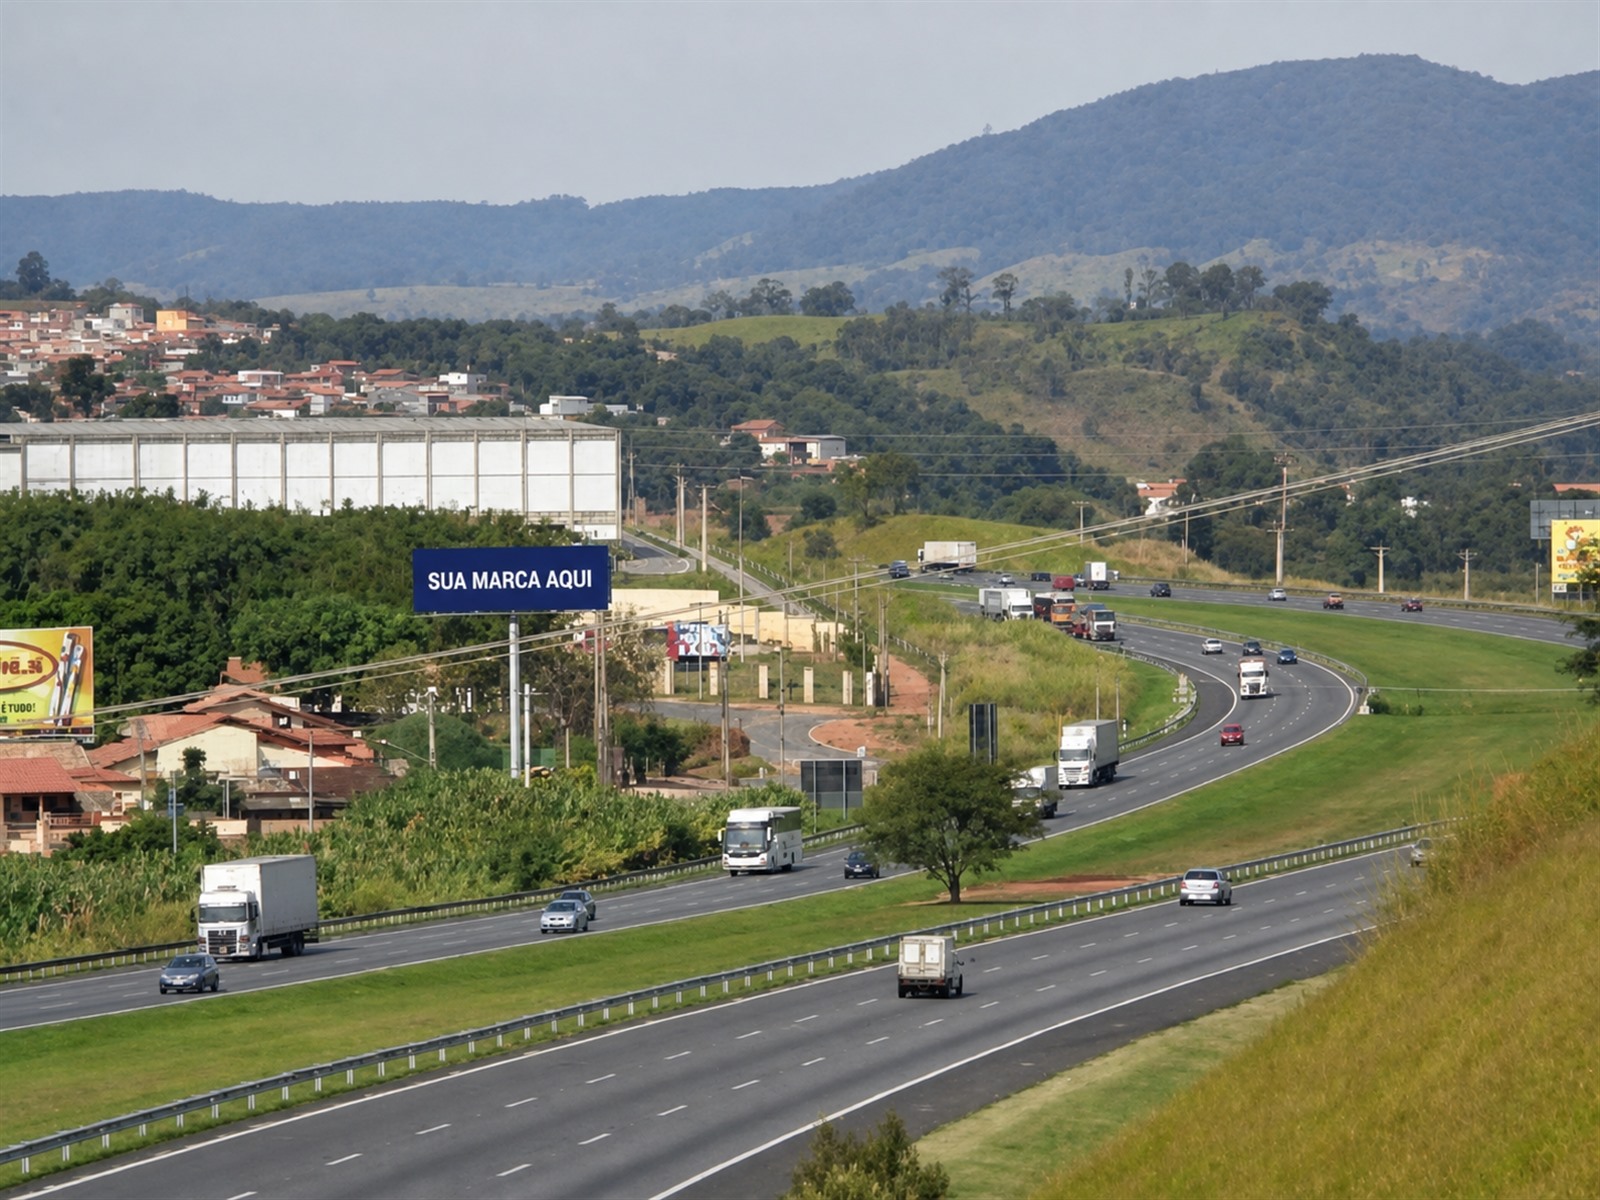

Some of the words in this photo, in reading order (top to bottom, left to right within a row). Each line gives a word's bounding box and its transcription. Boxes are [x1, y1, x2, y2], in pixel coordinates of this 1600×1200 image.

[428, 571, 467, 590] SUA
[472, 570, 541, 590] MARCA
[545, 569, 592, 590] AQUI
[8, 702, 36, 713] TUDO!
